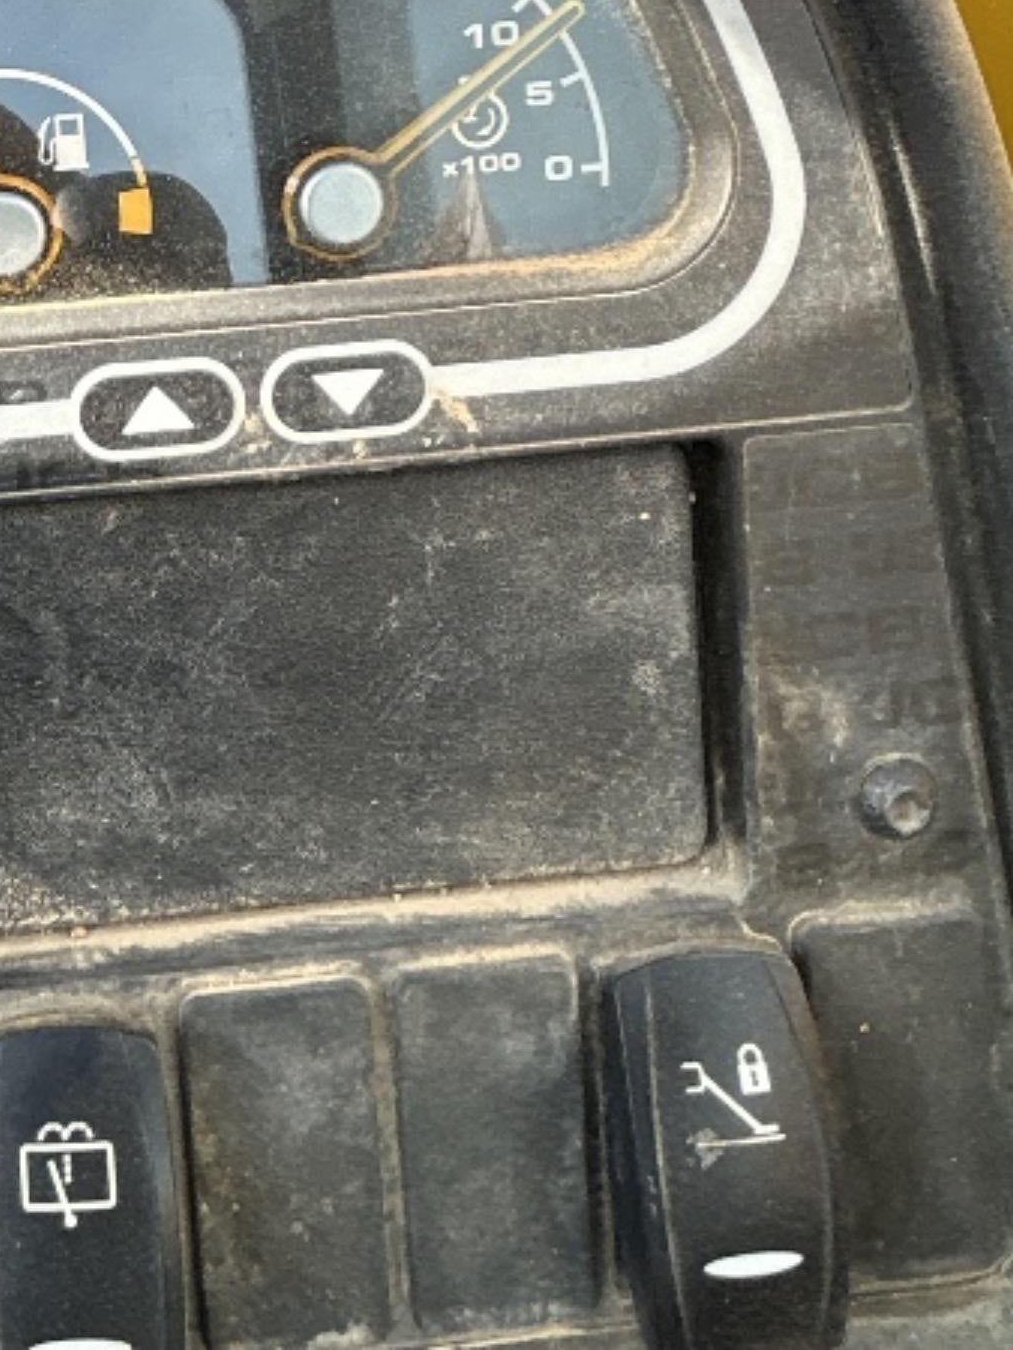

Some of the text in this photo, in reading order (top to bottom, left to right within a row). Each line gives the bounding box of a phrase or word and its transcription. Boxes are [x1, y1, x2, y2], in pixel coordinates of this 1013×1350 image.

[463, 20, 520, 49] 10
[524, 81, 556, 107] 5
[442, 152, 522, 178] x100
[544, 155, 574, 181] 0
